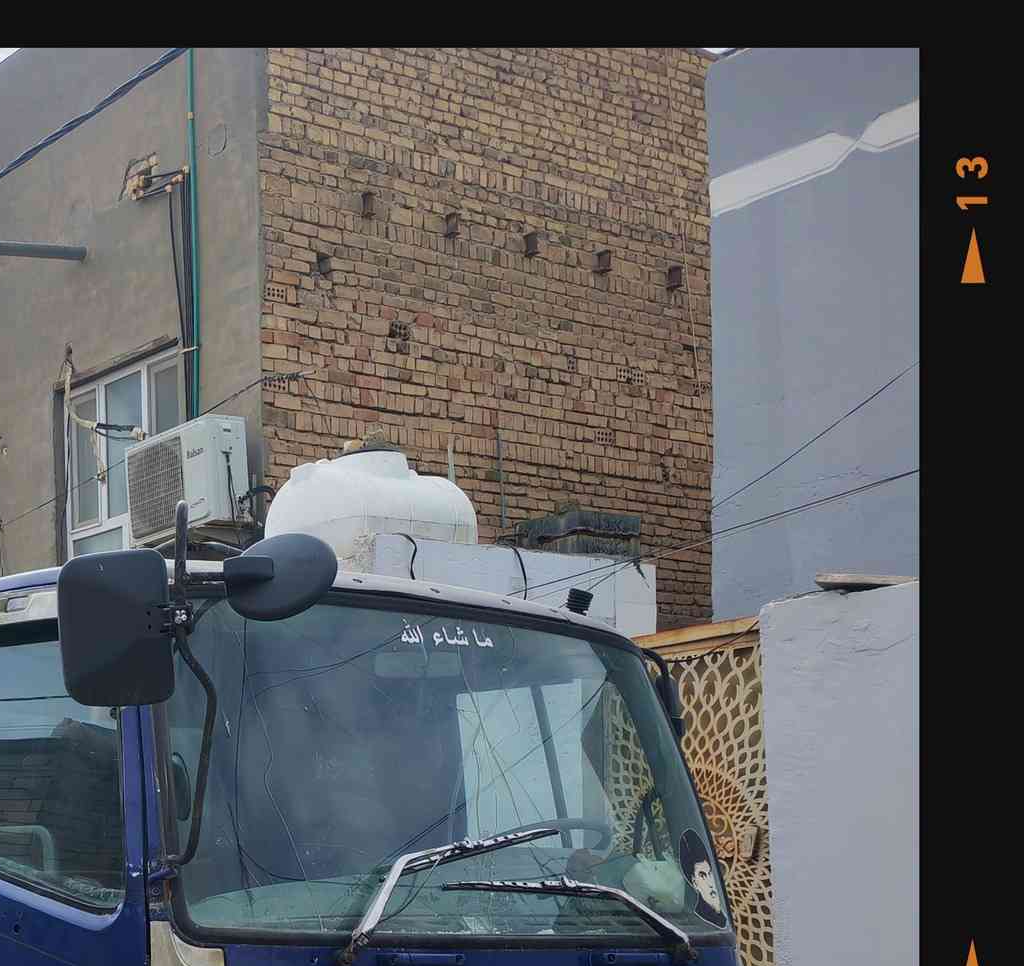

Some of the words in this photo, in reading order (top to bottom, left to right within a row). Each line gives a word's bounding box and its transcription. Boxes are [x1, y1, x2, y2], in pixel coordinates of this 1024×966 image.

[400, 618, 425, 645] الله
[432, 625, 470, 647] شاء
[472, 627, 495, 648] ما
